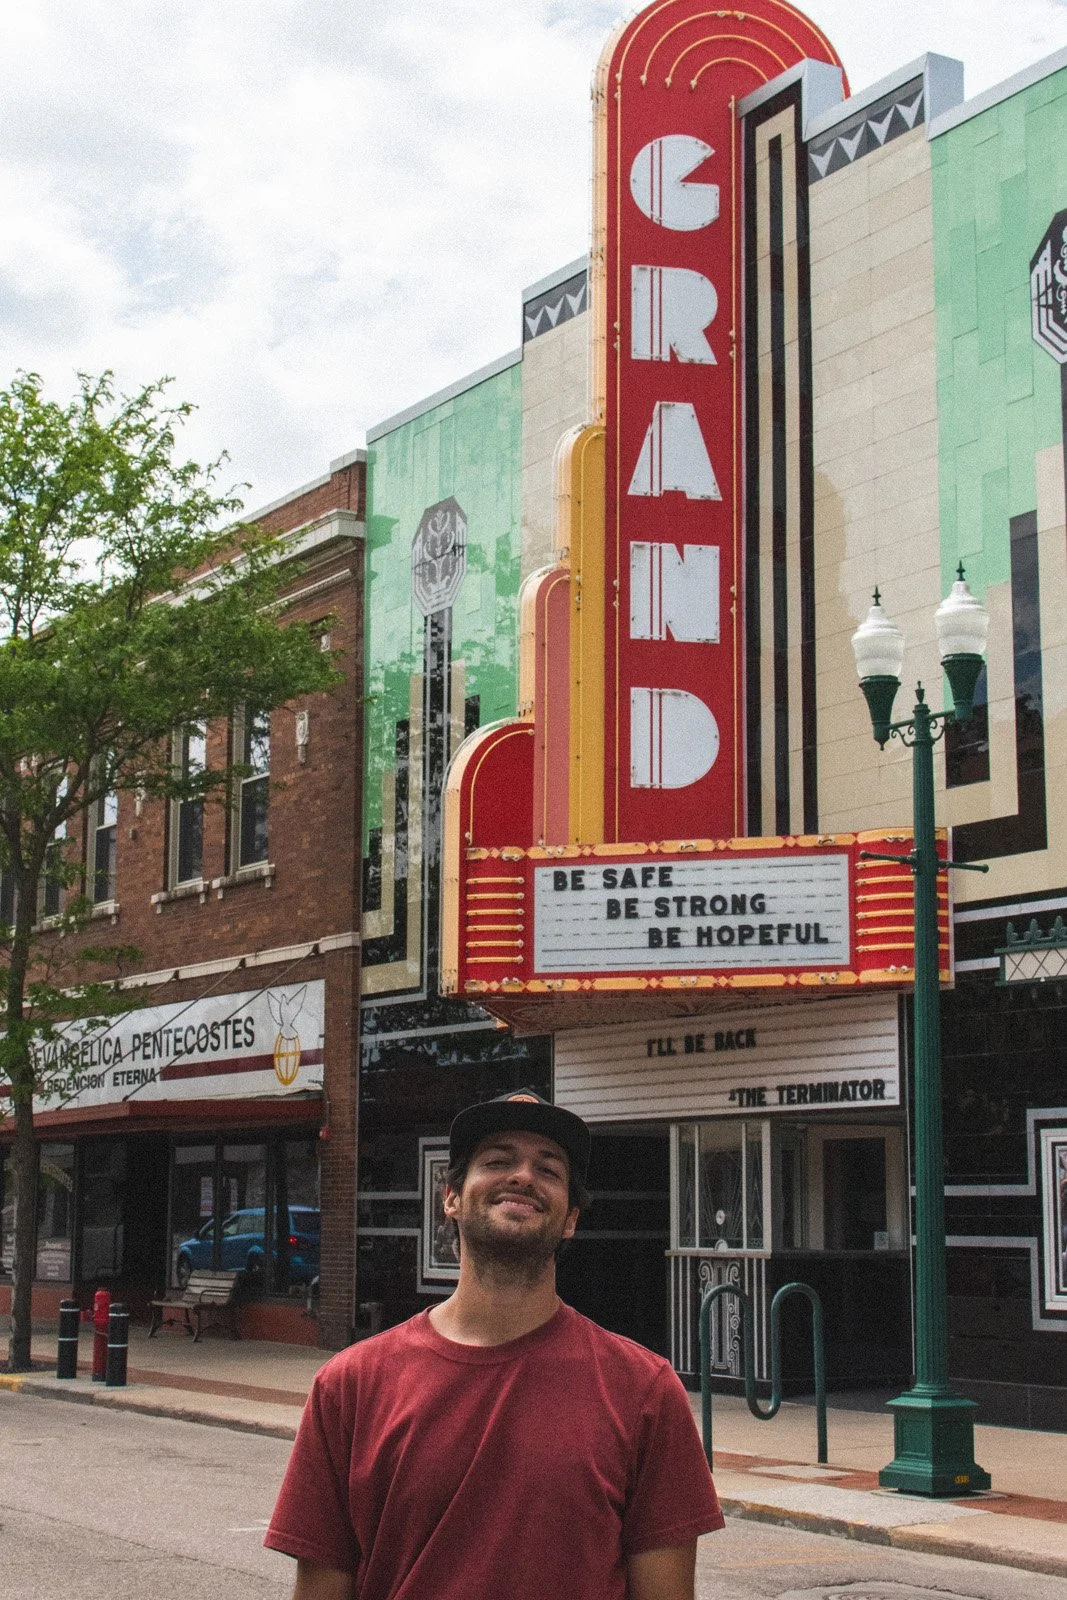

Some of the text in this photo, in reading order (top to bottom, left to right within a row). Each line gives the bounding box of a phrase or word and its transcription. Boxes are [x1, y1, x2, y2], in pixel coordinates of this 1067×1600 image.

[628, 133, 724, 792] GRAND
[553, 866, 673, 892] BE SAFE
[606, 893, 766, 920] BE STRONG
[648, 922, 829, 949] BE HOPEFUL
[132, 1016, 255, 1062] PENTECOSTES
[647, 1028, 757, 1058] I'LL BE BACK
[113, 1067, 157, 1087] ETERNA
[776, 1079, 885, 1106] TERMINATOR
